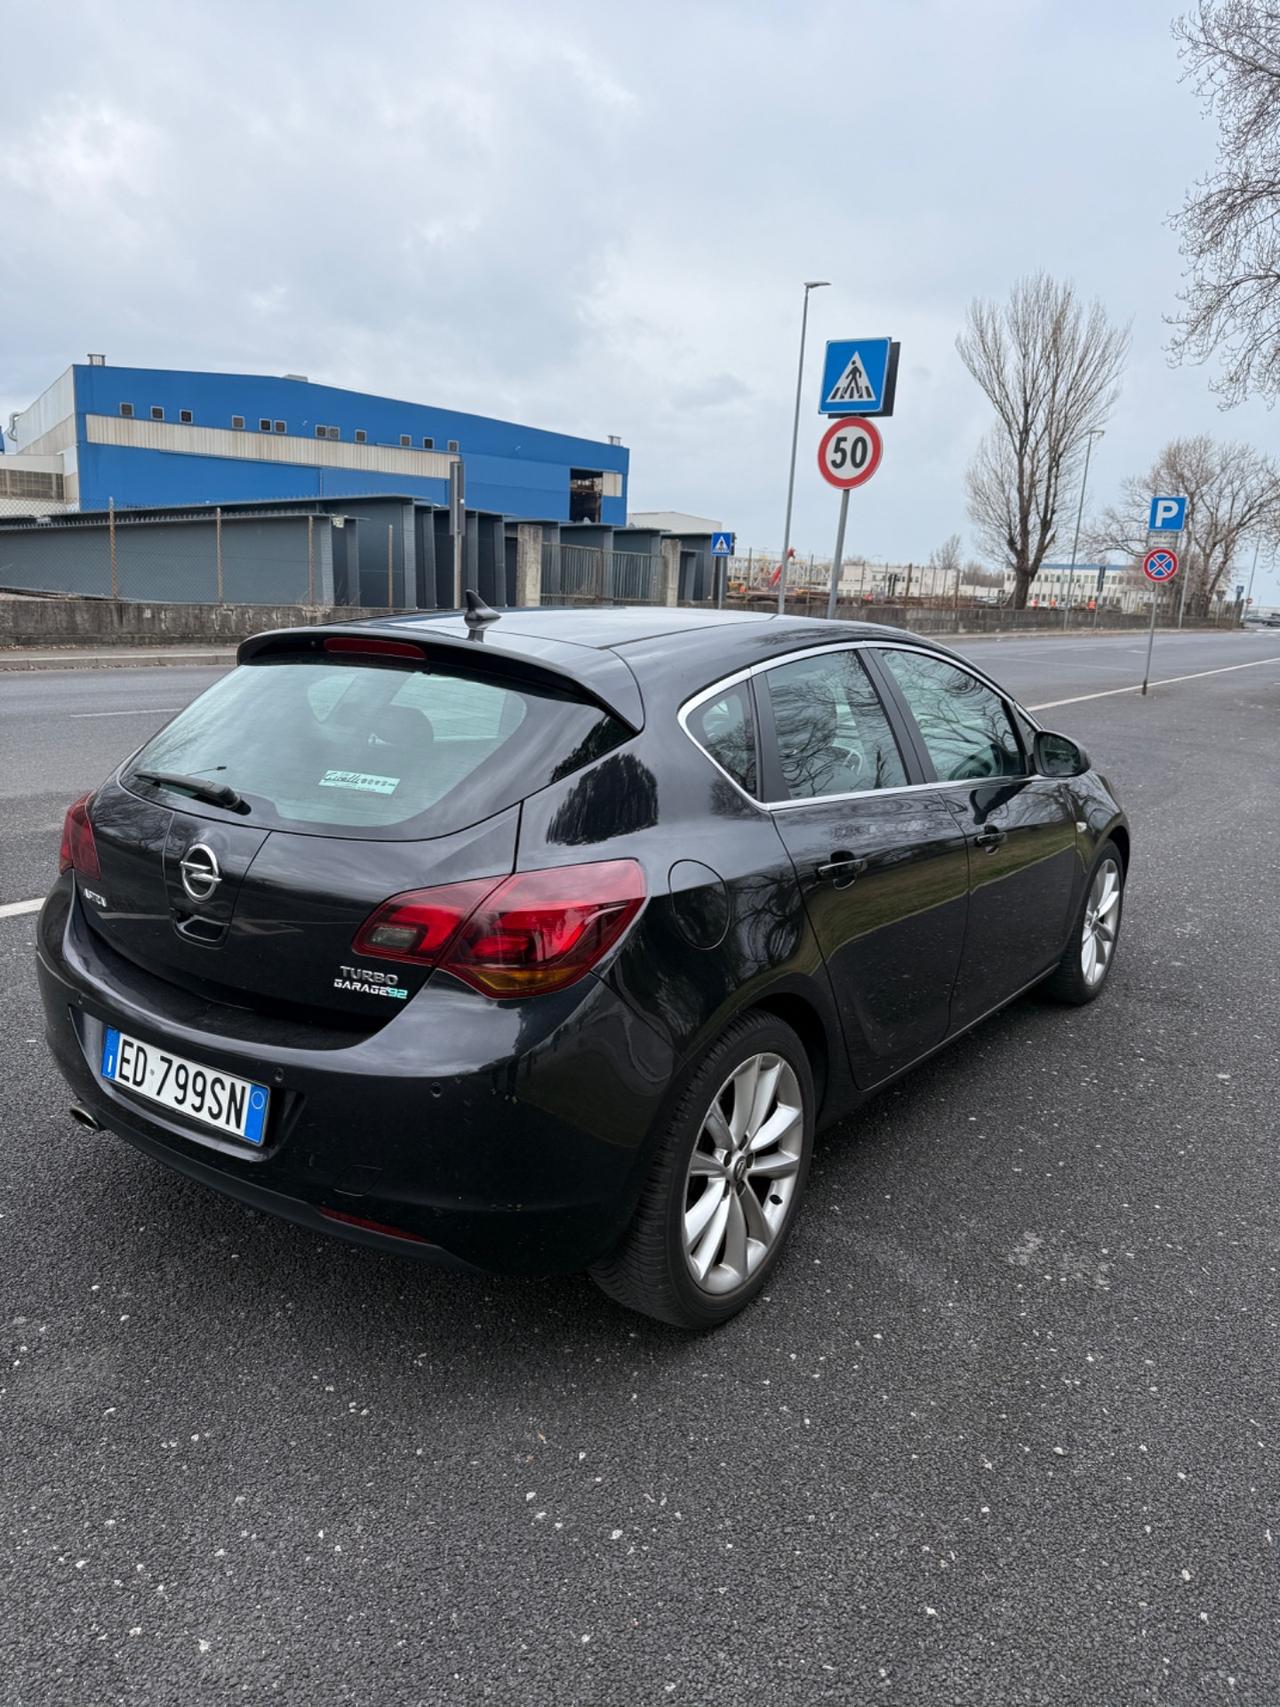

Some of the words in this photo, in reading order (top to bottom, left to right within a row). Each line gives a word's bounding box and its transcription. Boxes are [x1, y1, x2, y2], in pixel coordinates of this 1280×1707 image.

[831, 436, 868, 469] 50
[1154, 499, 1179, 528] P
[333, 978, 408, 1000] GARAGE92
[339, 965, 399, 986] TURBO
[107, 1055, 113, 1073] I
[118, 1039, 148, 1087] ED
[156, 1055, 246, 1130] 799SN
